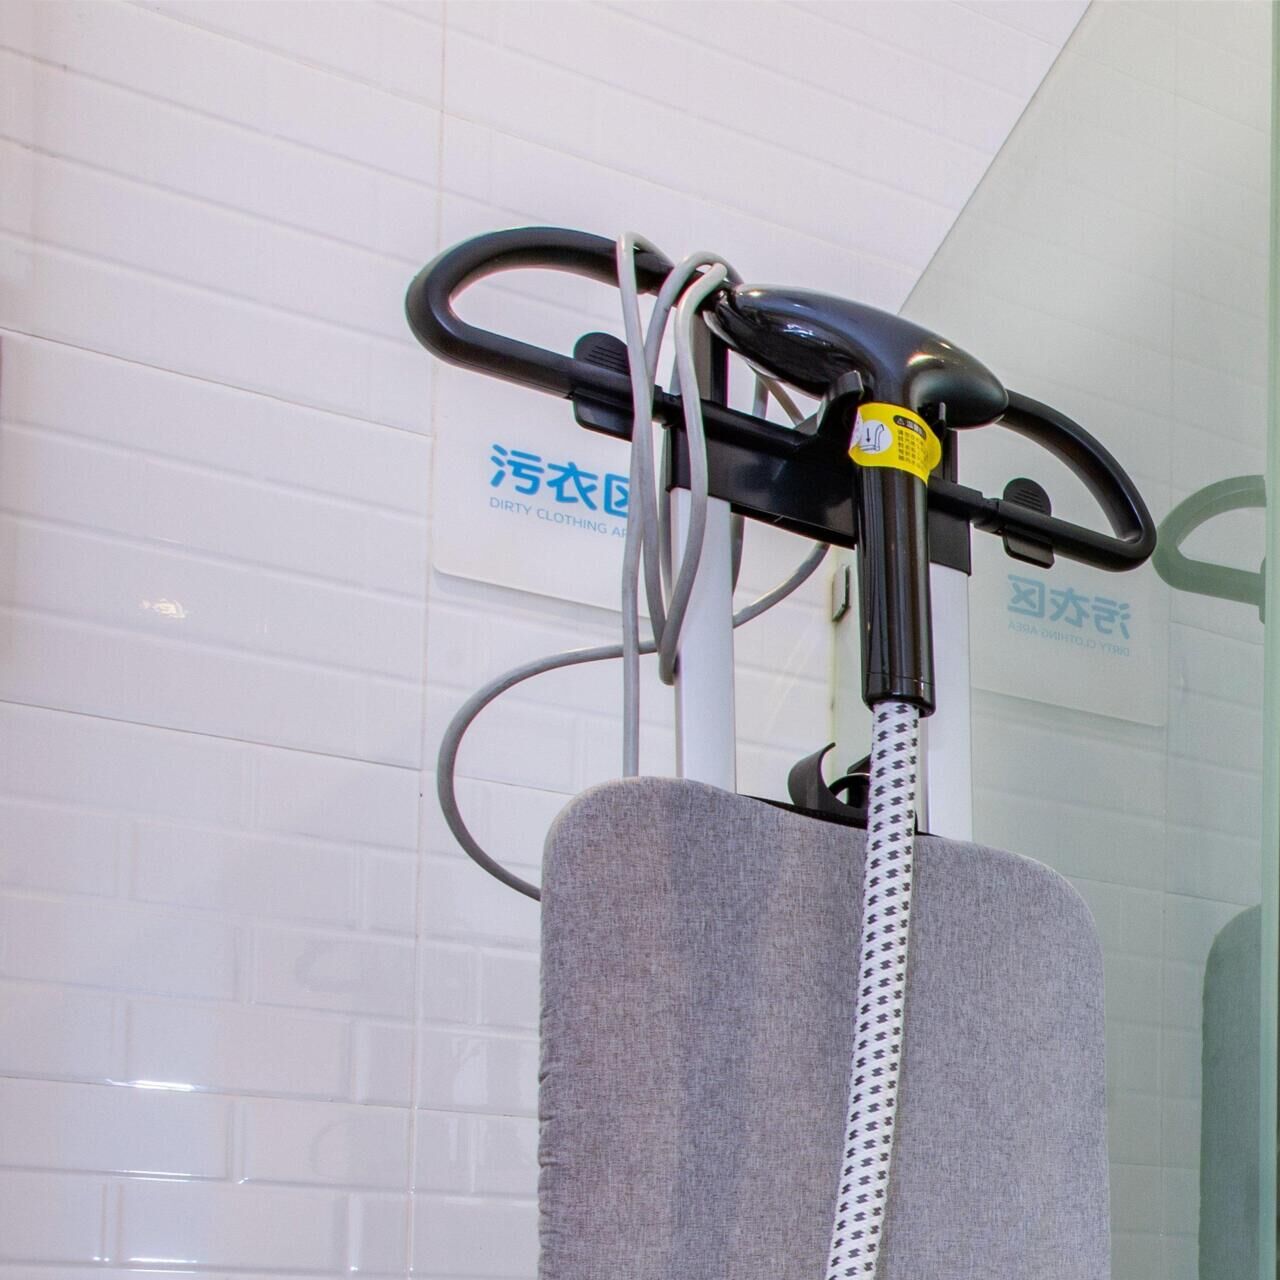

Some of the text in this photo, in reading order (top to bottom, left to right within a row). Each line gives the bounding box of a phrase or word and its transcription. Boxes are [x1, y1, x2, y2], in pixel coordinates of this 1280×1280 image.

[490, 444, 632, 519] 污衣区
[490, 497, 532, 516] DIRTY
[536, 508, 607, 535] CLOTHING
